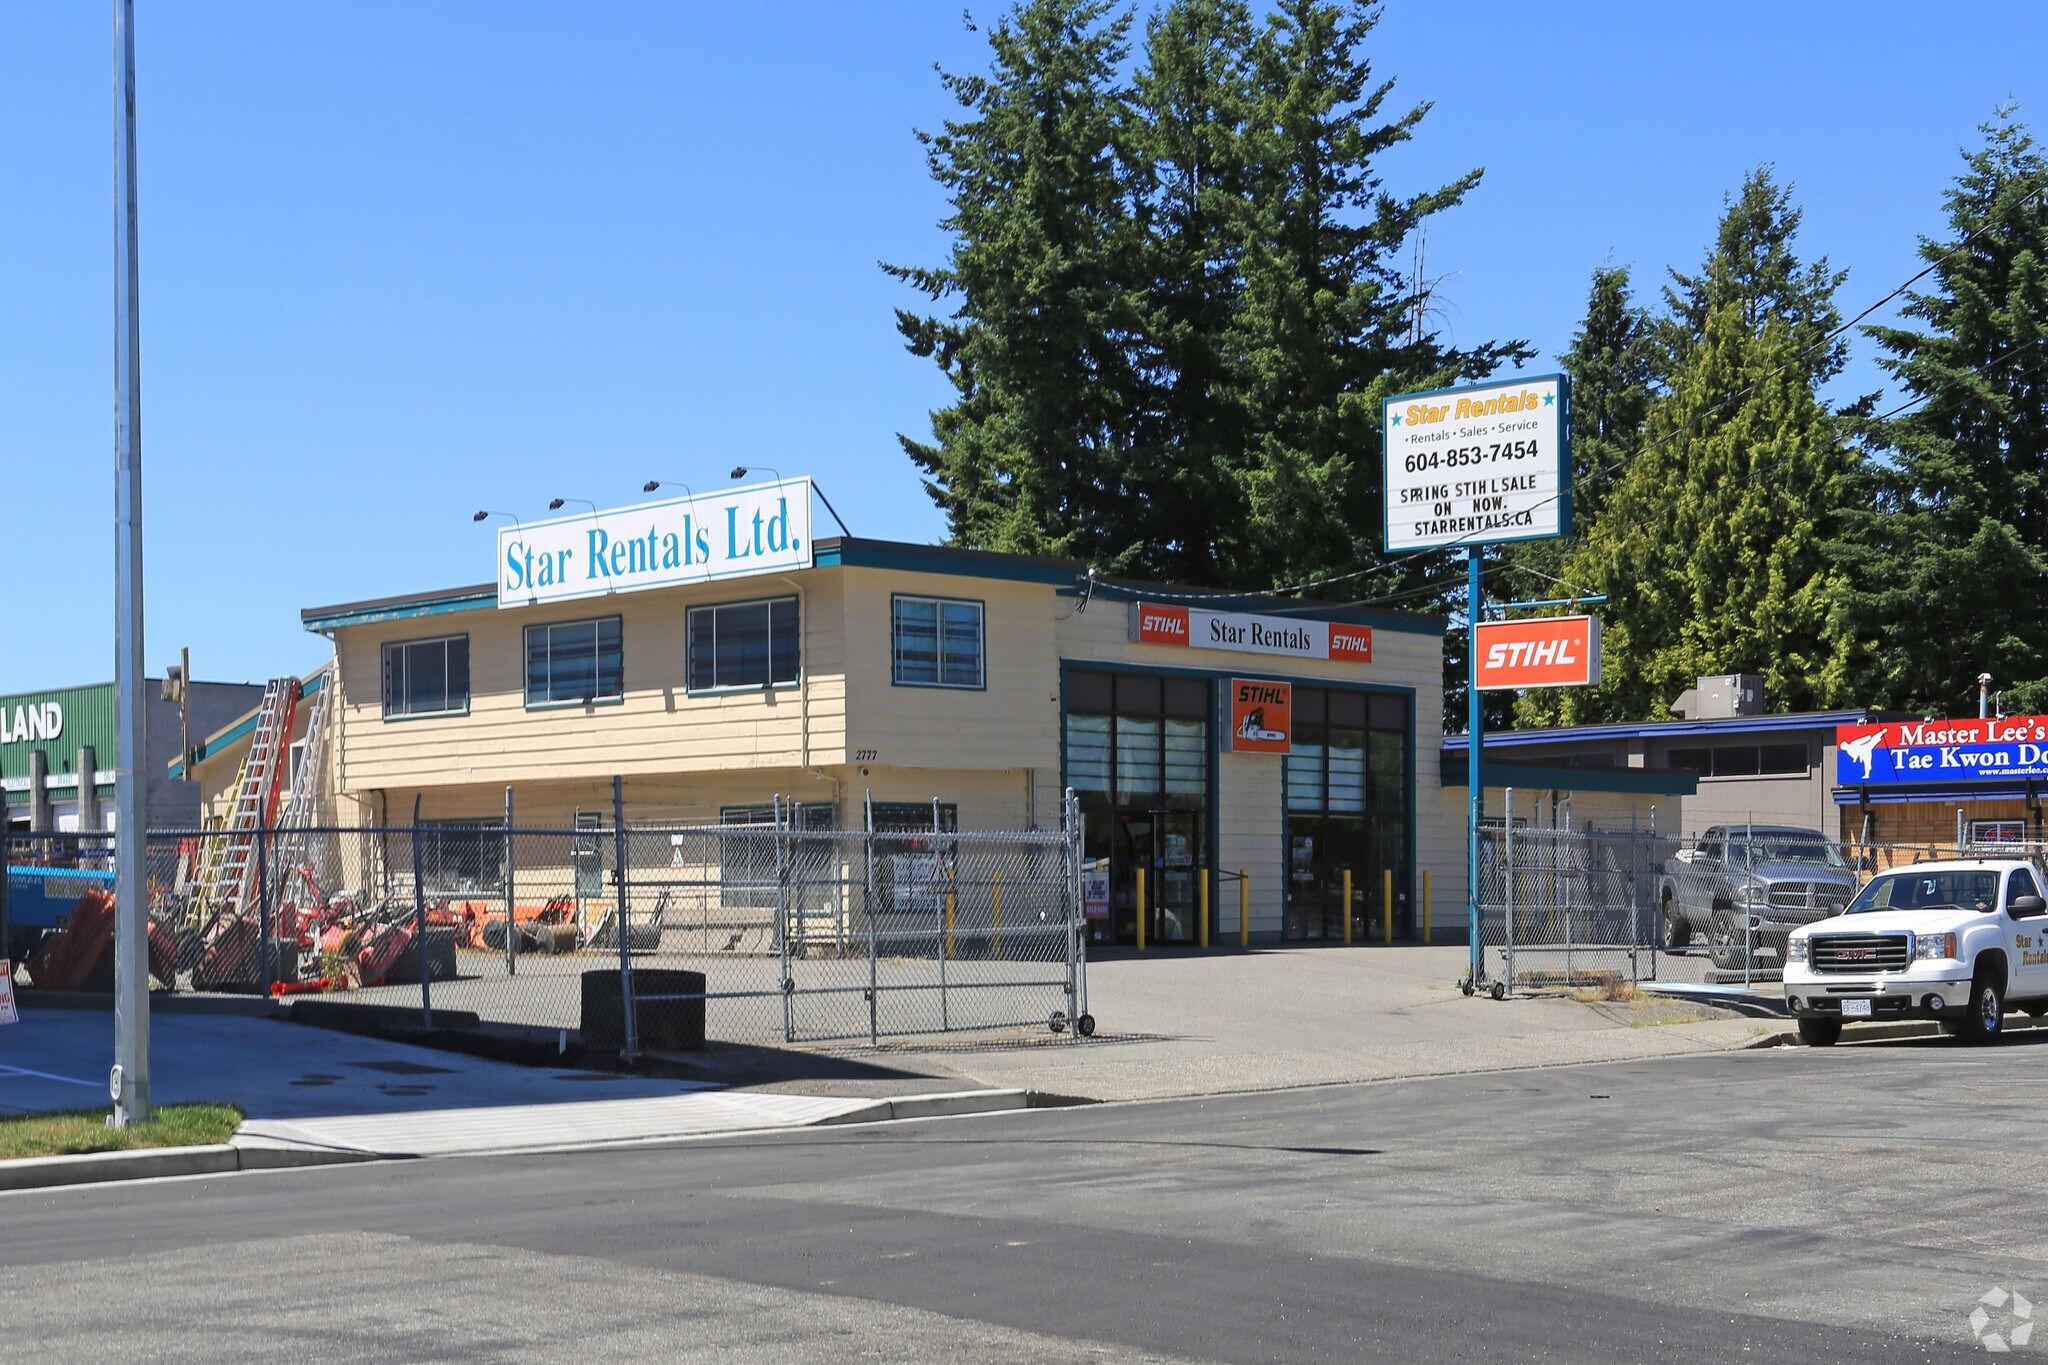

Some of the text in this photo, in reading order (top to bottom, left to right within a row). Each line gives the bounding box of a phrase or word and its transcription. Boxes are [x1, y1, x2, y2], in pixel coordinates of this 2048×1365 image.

[1405, 390, 1539, 426] Star Rentals
[1411, 419, 1538, 444] Rentals Sales Service
[1405, 439, 1539, 473] 604-853-7454
[1401, 484, 1449, 503] SPRING
[1502, 475, 1537, 492] SALE
[1434, 502, 1452, 517] ON
[1415, 510, 1533, 536] STARRENTALS.CA
[506, 497, 800, 591] Star Rentals Ltd.
[1143, 615, 1368, 652] STIHL Star Rentals STIHL
[1484, 639, 1576, 669] STIHL
[1238, 685, 1284, 705] STIHL
[1899, 718, 2046, 746] Master Lee's
[856, 749, 878, 760] 2777
[1890, 748, 1933, 770] Tae
[1939, 746, 2010, 768] Kwon
[1978, 765, 2048, 776] www.masterlee.c
[1836, 948, 1877, 959] GMC
[2016, 934, 2032, 948] Star
